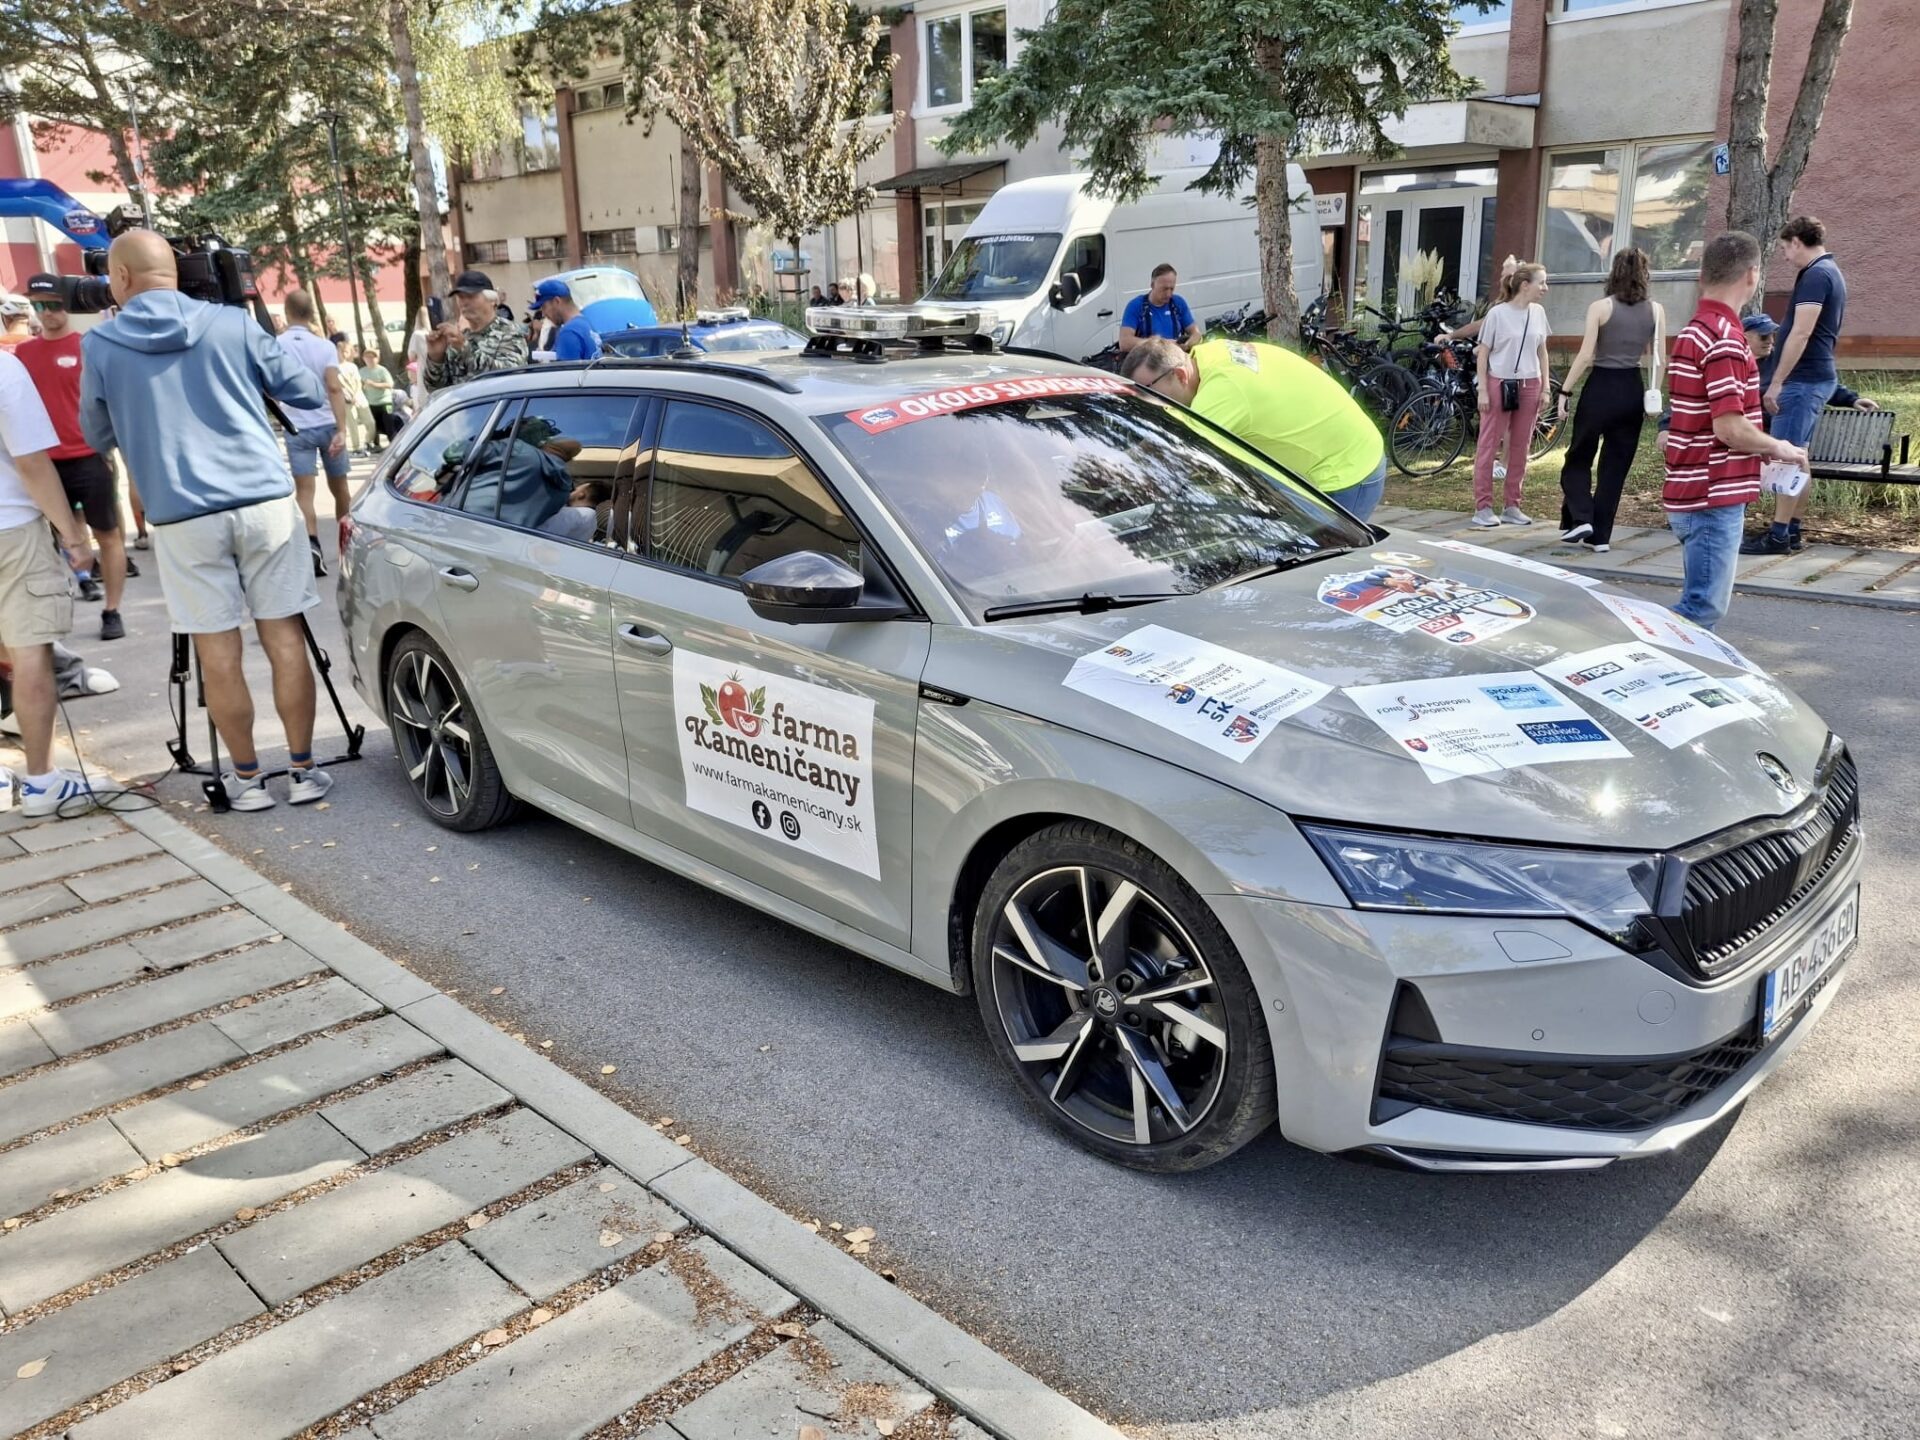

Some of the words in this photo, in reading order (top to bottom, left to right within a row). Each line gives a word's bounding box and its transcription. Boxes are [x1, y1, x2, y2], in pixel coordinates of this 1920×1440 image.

[899, 386, 999, 417] OKOLO
[1000, 377, 1127, 398] SLOVENSKA
[1383, 595, 1440, 617] OKOLO
[1417, 590, 1504, 620] SLOVENSKA
[1581, 663, 1621, 680] TIPOS
[1210, 701, 1234, 722] SK
[1376, 706, 1404, 715] FOND
[1426, 698, 1472, 708] PODPORU
[1655, 701, 1696, 719] EUROVIA
[772, 702, 859, 761] farma
[1528, 728, 1581, 738] SLOVENSKO
[685, 715, 860, 807] Kameničany
[692, 761, 863, 833] www.farmakamenicany.sk
[1778, 955, 1802, 1009] AB
